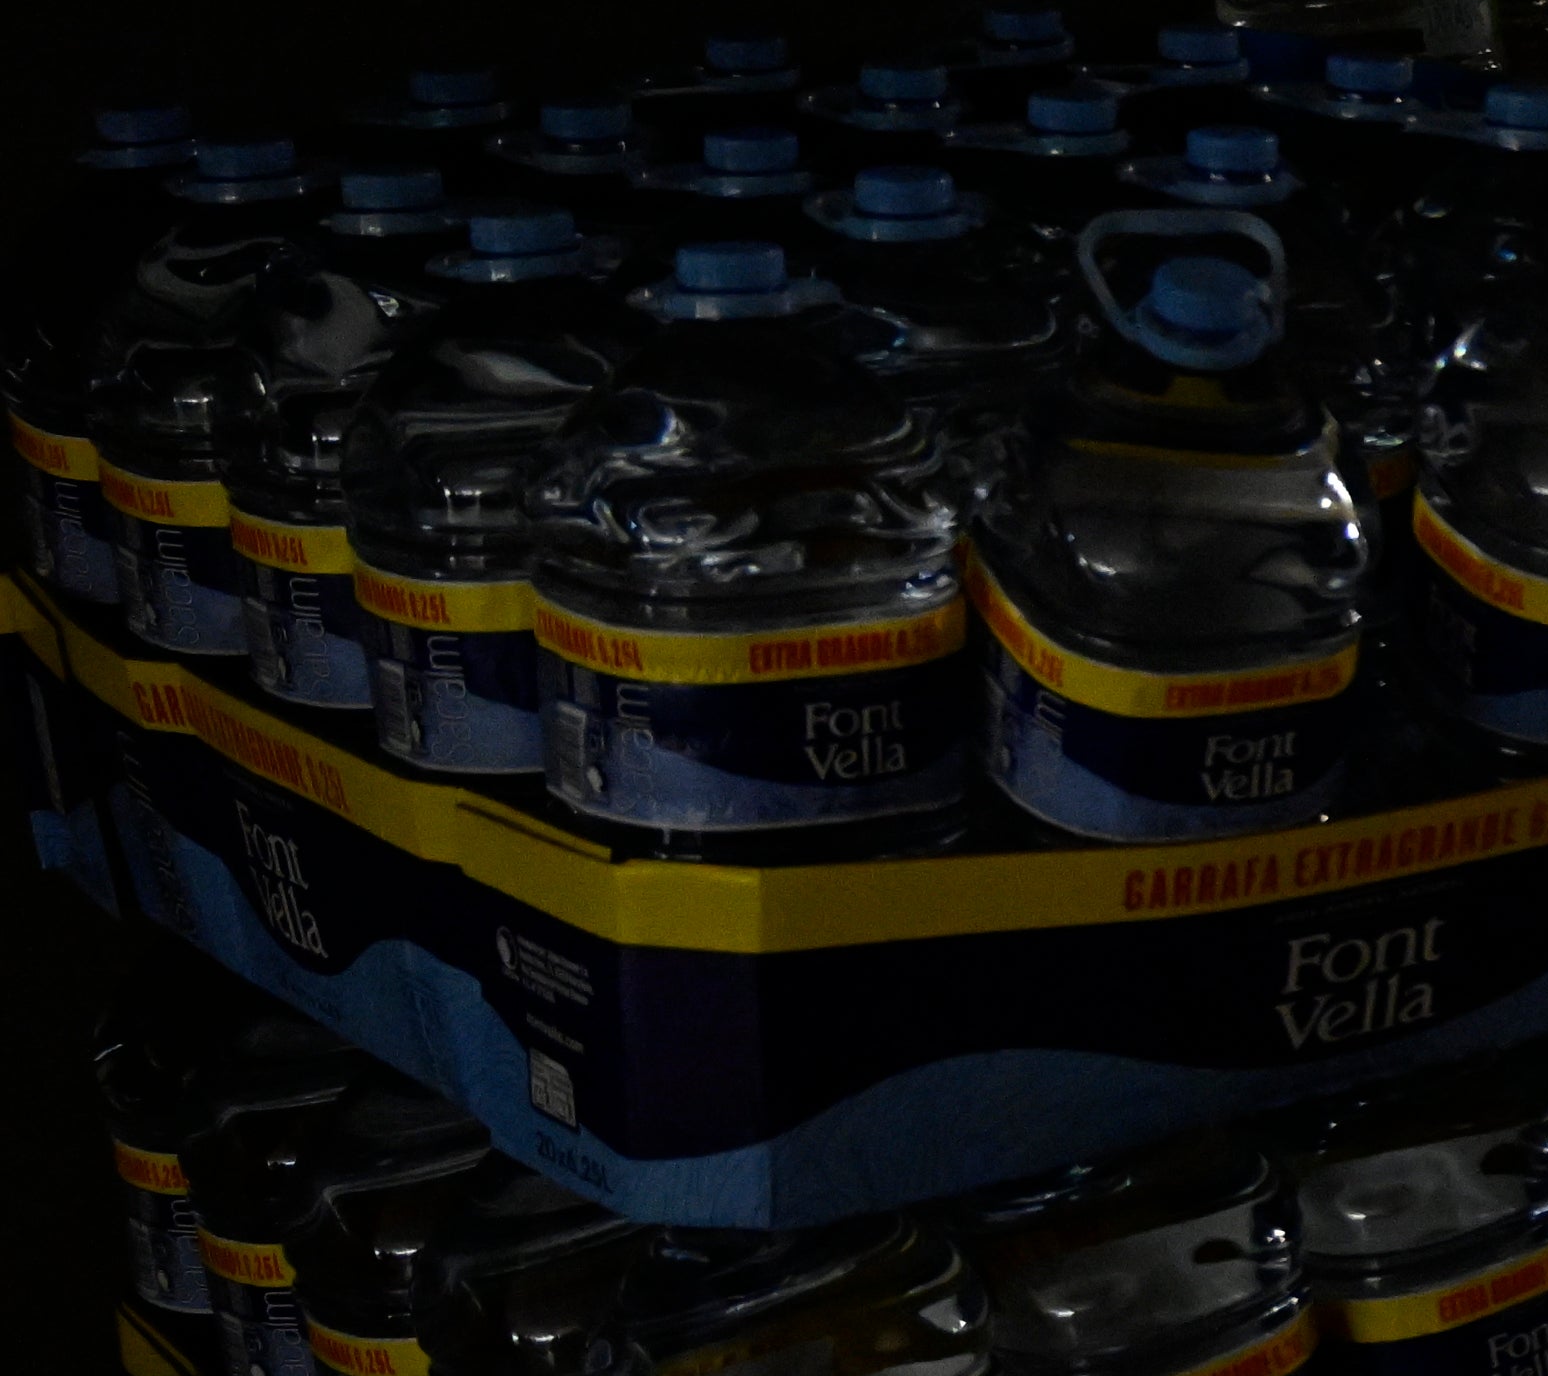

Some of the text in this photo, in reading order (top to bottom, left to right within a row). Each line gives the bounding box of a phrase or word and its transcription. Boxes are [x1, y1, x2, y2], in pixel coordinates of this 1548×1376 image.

[803, 698, 905, 742] Font
[802, 734, 908, 782] Vella
[1203, 728, 1299, 767] Font
[1199, 761, 1295, 802] Vella
[1124, 852, 1279, 913] GARRAFA
[1294, 807, 1519, 888] EXTRAGRANDE
[1279, 913, 1447, 995] Font
[1273, 972, 1438, 1052] Vella
